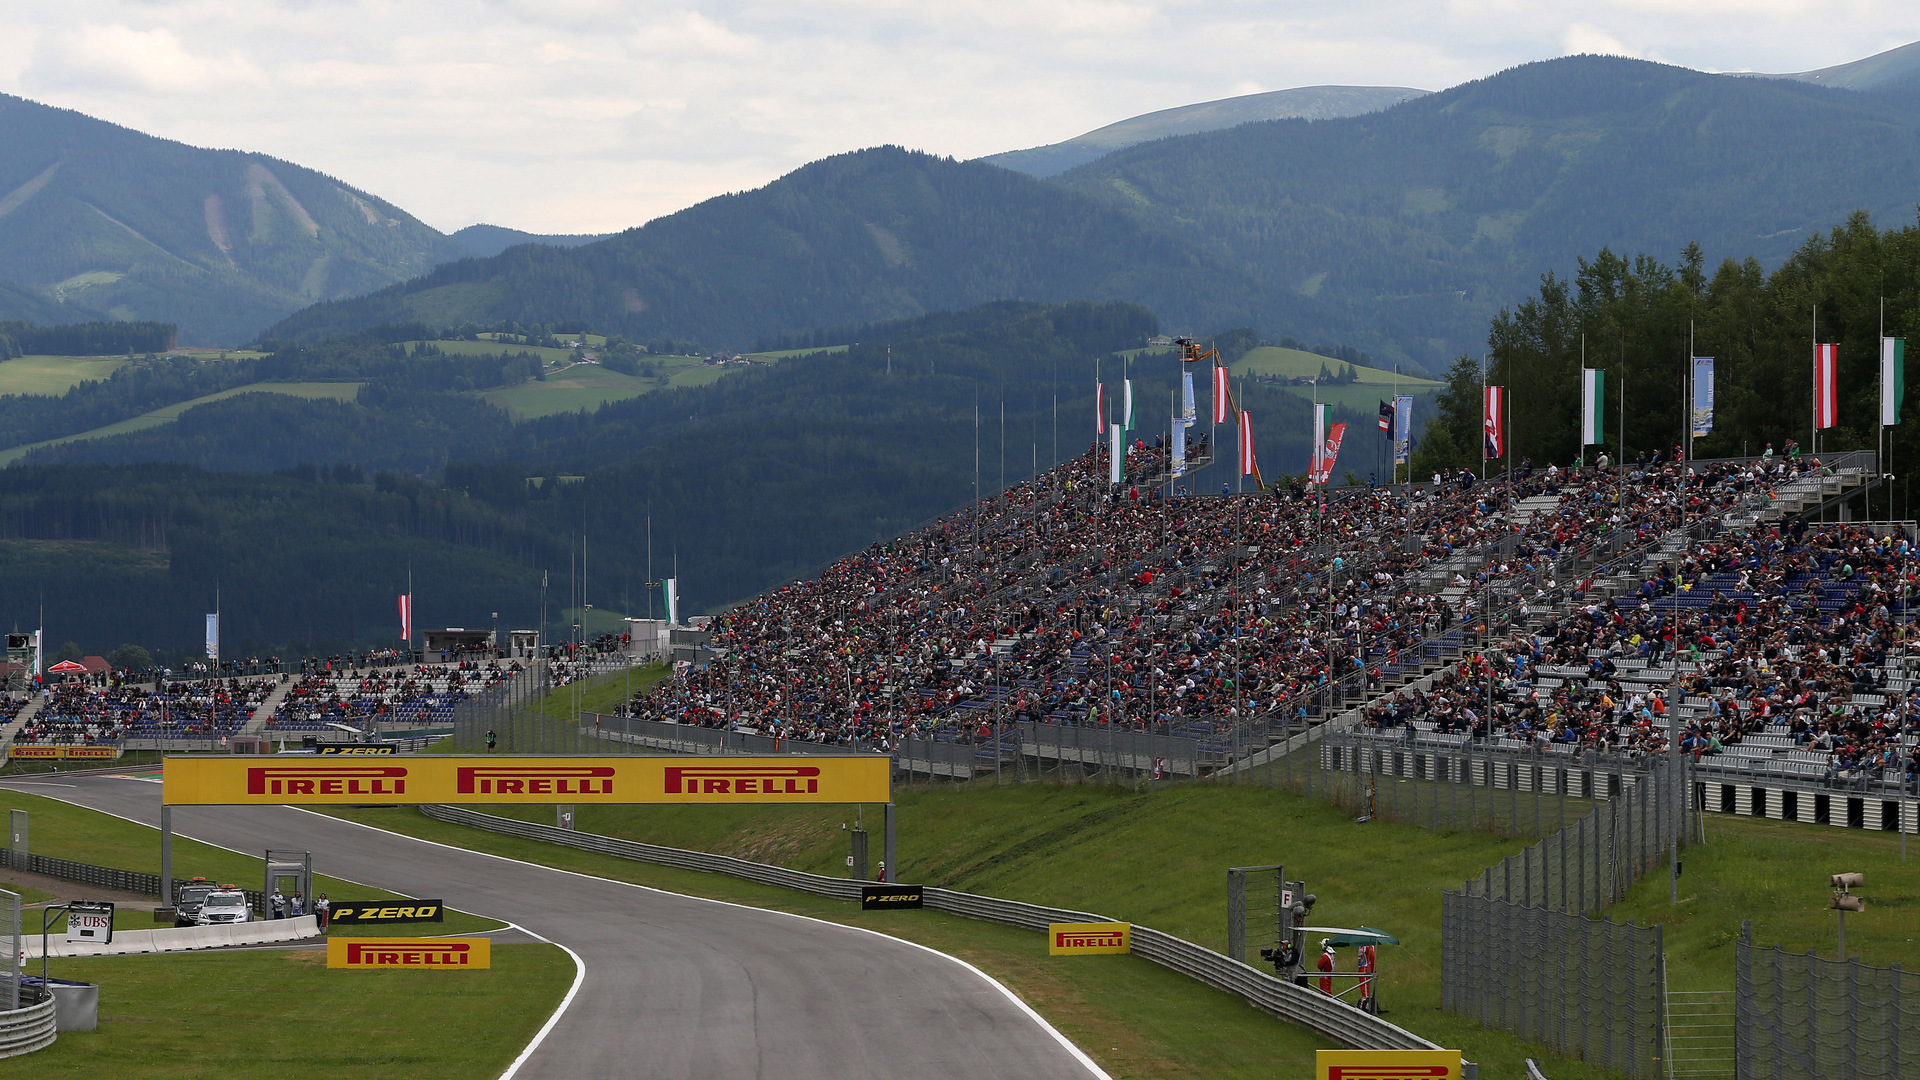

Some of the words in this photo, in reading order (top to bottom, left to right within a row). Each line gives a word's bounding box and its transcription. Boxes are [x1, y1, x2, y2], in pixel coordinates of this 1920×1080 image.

[322, 747, 335, 755] P
[338, 747, 392, 755] ZERO
[248, 767, 407, 794] PIRELLI
[458, 767, 615, 794] PIRELLI
[665, 767, 820, 794] PIRELLI
[848, 857, 853, 865] F
[878, 894, 920, 902] ZERO
[1284, 893, 1290, 905] F
[332, 908, 354, 920] P
[358, 906, 437, 920] ZERO
[83, 916, 108, 928] UBS
[1056, 931, 1123, 948] PIRELLI
[347, 943, 470, 965] PIRELLI
